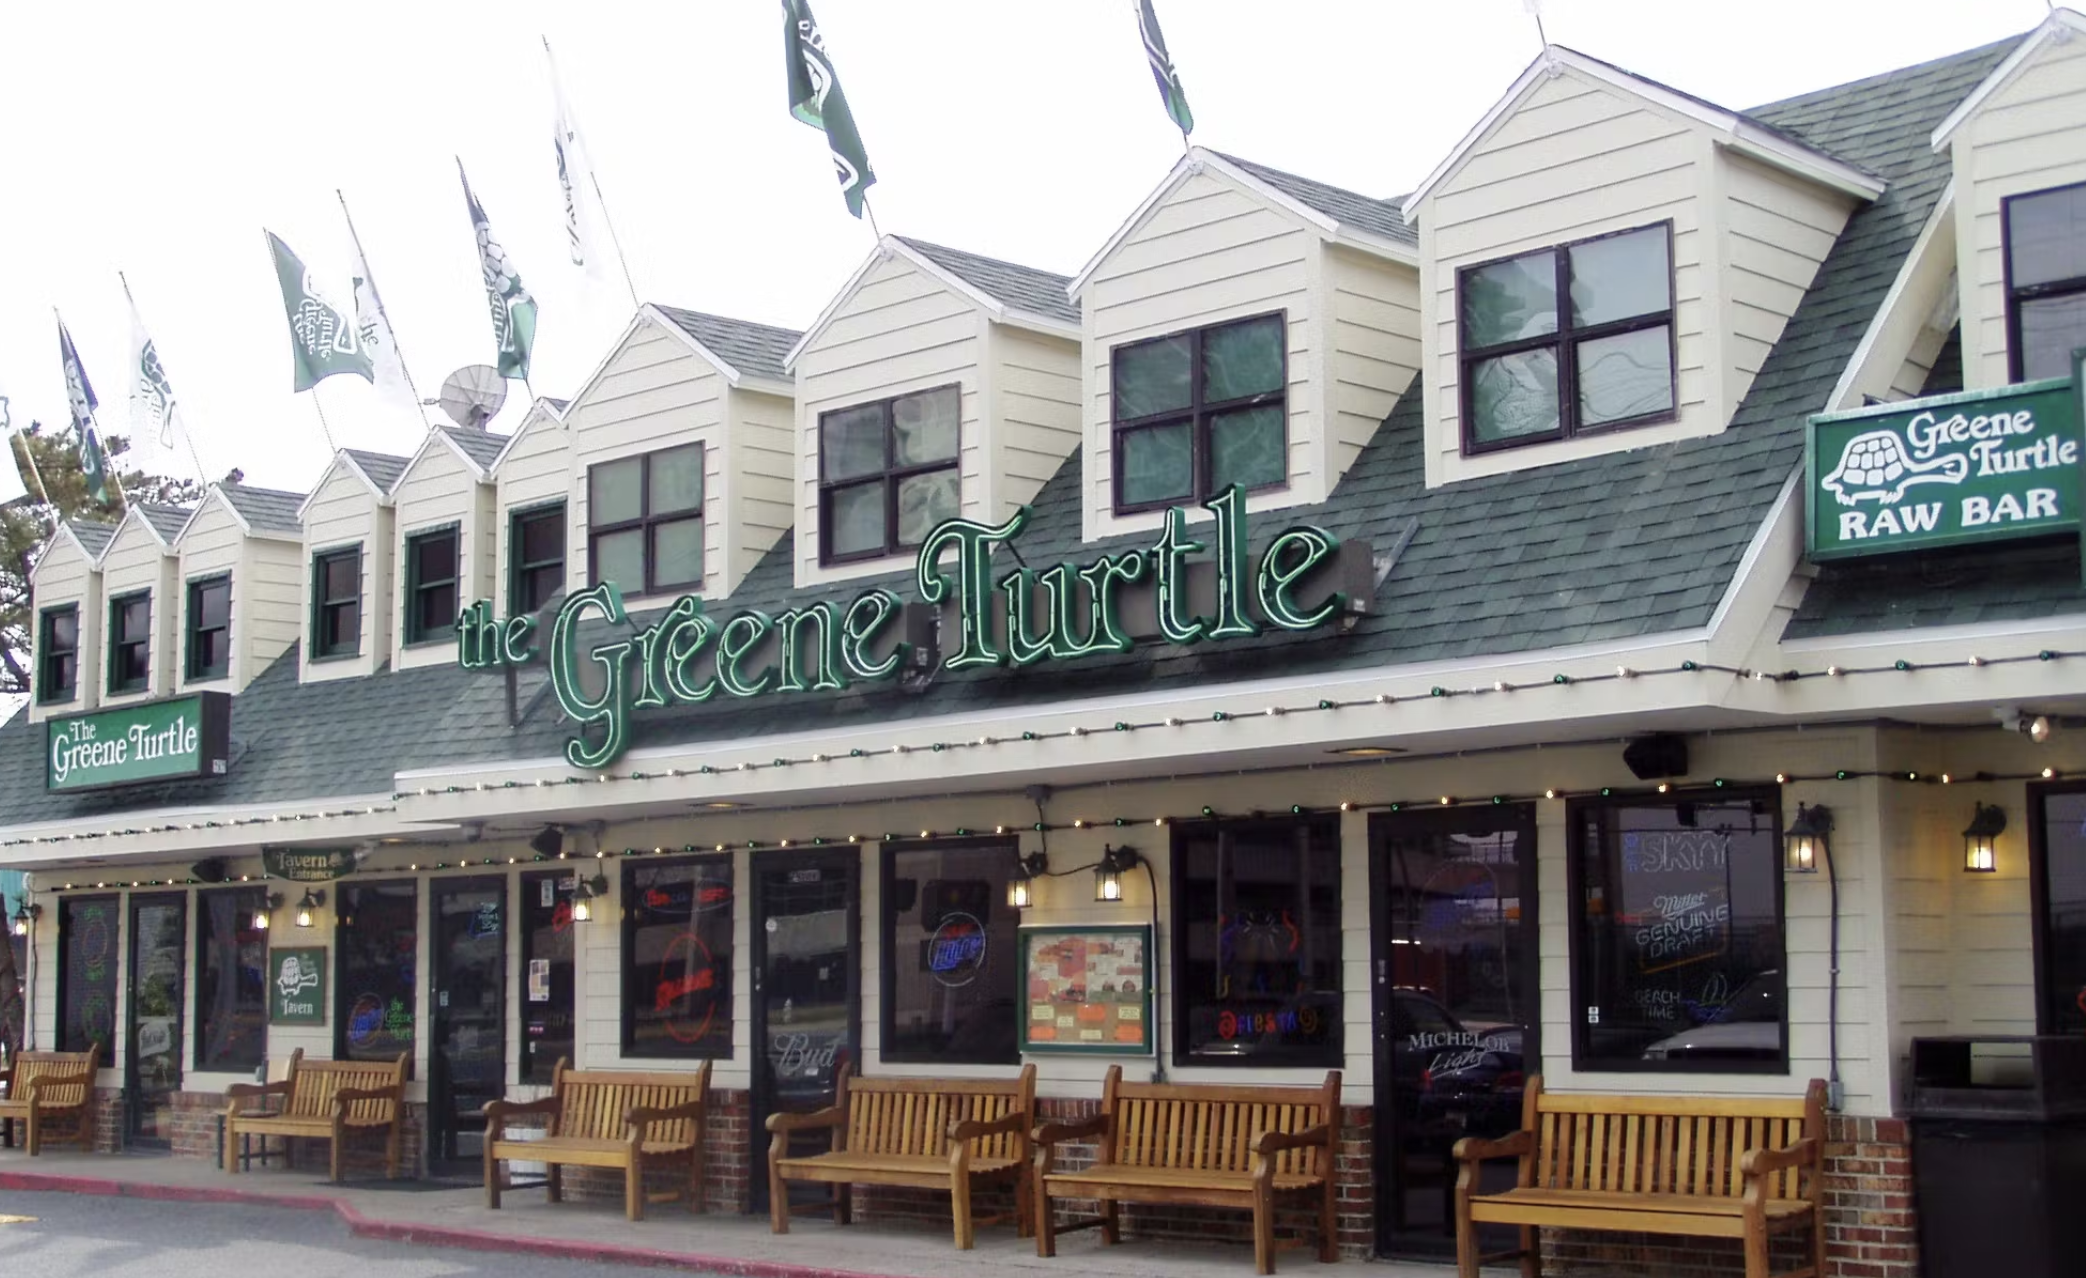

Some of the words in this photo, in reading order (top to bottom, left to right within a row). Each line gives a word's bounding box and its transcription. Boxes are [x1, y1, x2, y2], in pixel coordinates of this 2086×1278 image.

[1907, 410, 2034, 458] Greene
[1970, 434, 2078, 476] Turtle
[1839, 502, 1943, 540] RAW
[1961, 488, 2059, 527] BAR
[458, 599, 539, 670] the
[551, 581, 910, 768] Greene
[916, 482, 1345, 672] Turtle
[69, 719, 97, 742] The
[53, 734, 127, 782] Greene
[128, 715, 197, 760] Turtle
[278, 851, 327, 869] Tavern
[289, 868, 334, 880] Entrance
[1652, 891, 1708, 918] Miller
[1635, 903, 1729, 945] GENUINE
[280, 999, 314, 1016] Tavern
[775, 1033, 840, 1078] Bud
[1407, 1031, 1510, 1053] MICHELOB
[1429, 1047, 1485, 1073] Light
